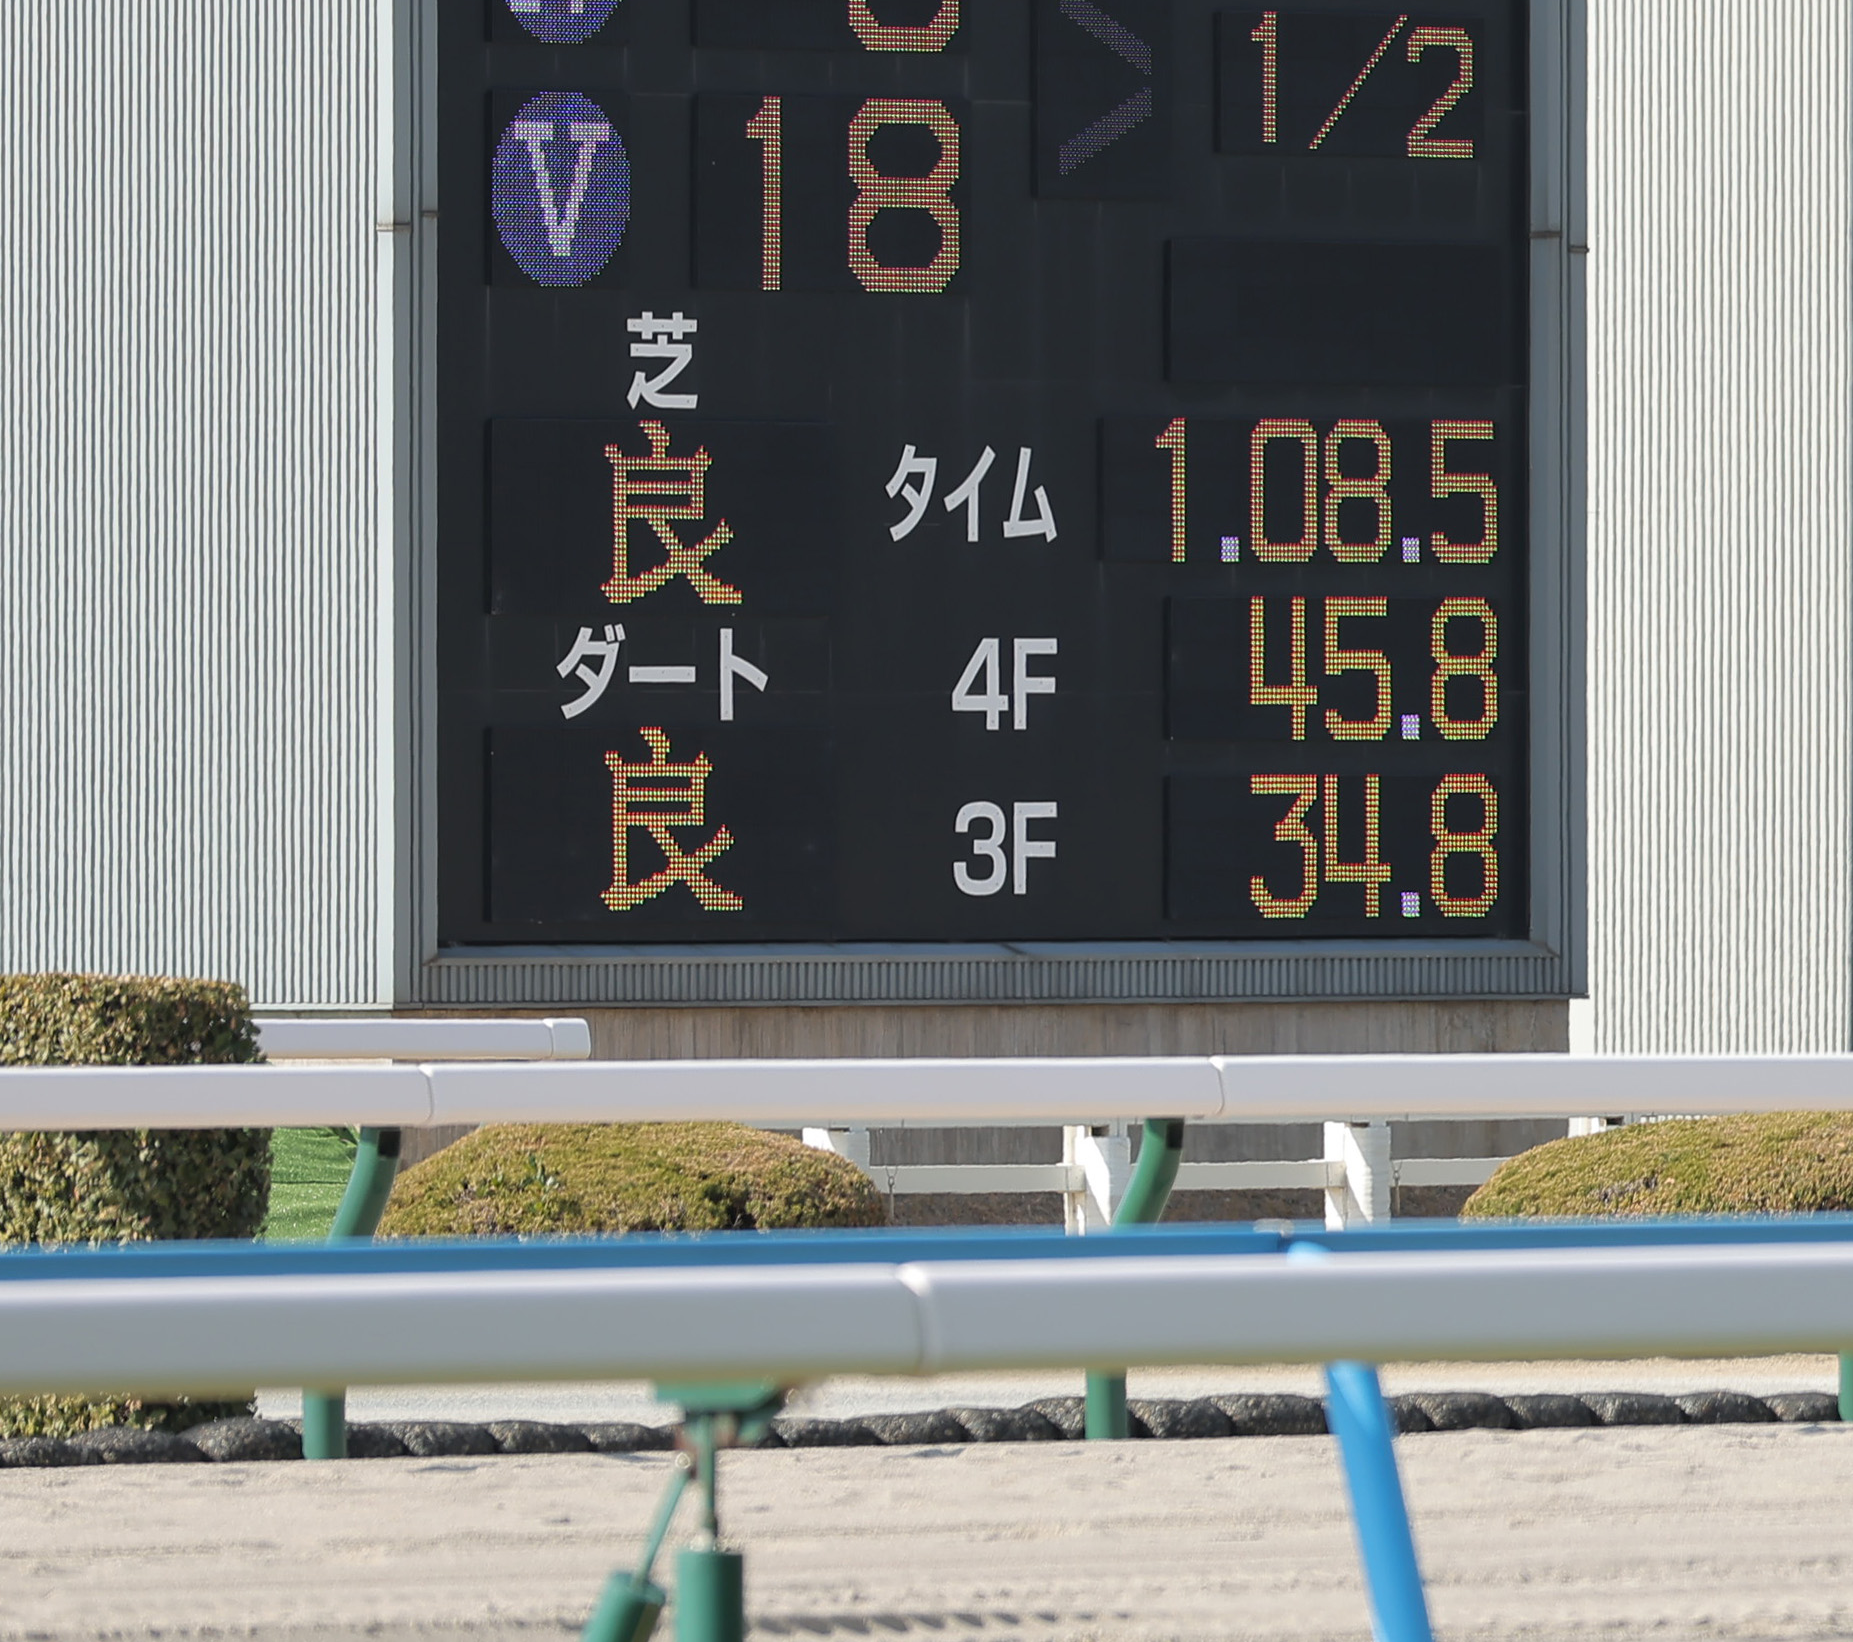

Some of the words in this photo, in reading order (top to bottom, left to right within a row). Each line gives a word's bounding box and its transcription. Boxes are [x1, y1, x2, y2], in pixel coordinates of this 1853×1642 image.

[1251, 12, 1473, 158] 1/2
[747, 97, 959, 292] 18
[627, 312, 697, 409] 芝
[601, 421, 742, 604] 良
[886, 445, 1057, 542] タイム
[1156, 418, 1497, 563] 1.08.5
[557, 624, 768, 720] ダート
[952, 638, 1057, 730] 4F
[1250, 596, 1497, 740] 45.8
[601, 727, 742, 911] 良
[954, 802, 1057, 895] 3F
[1251, 773, 1497, 918] 34.8
